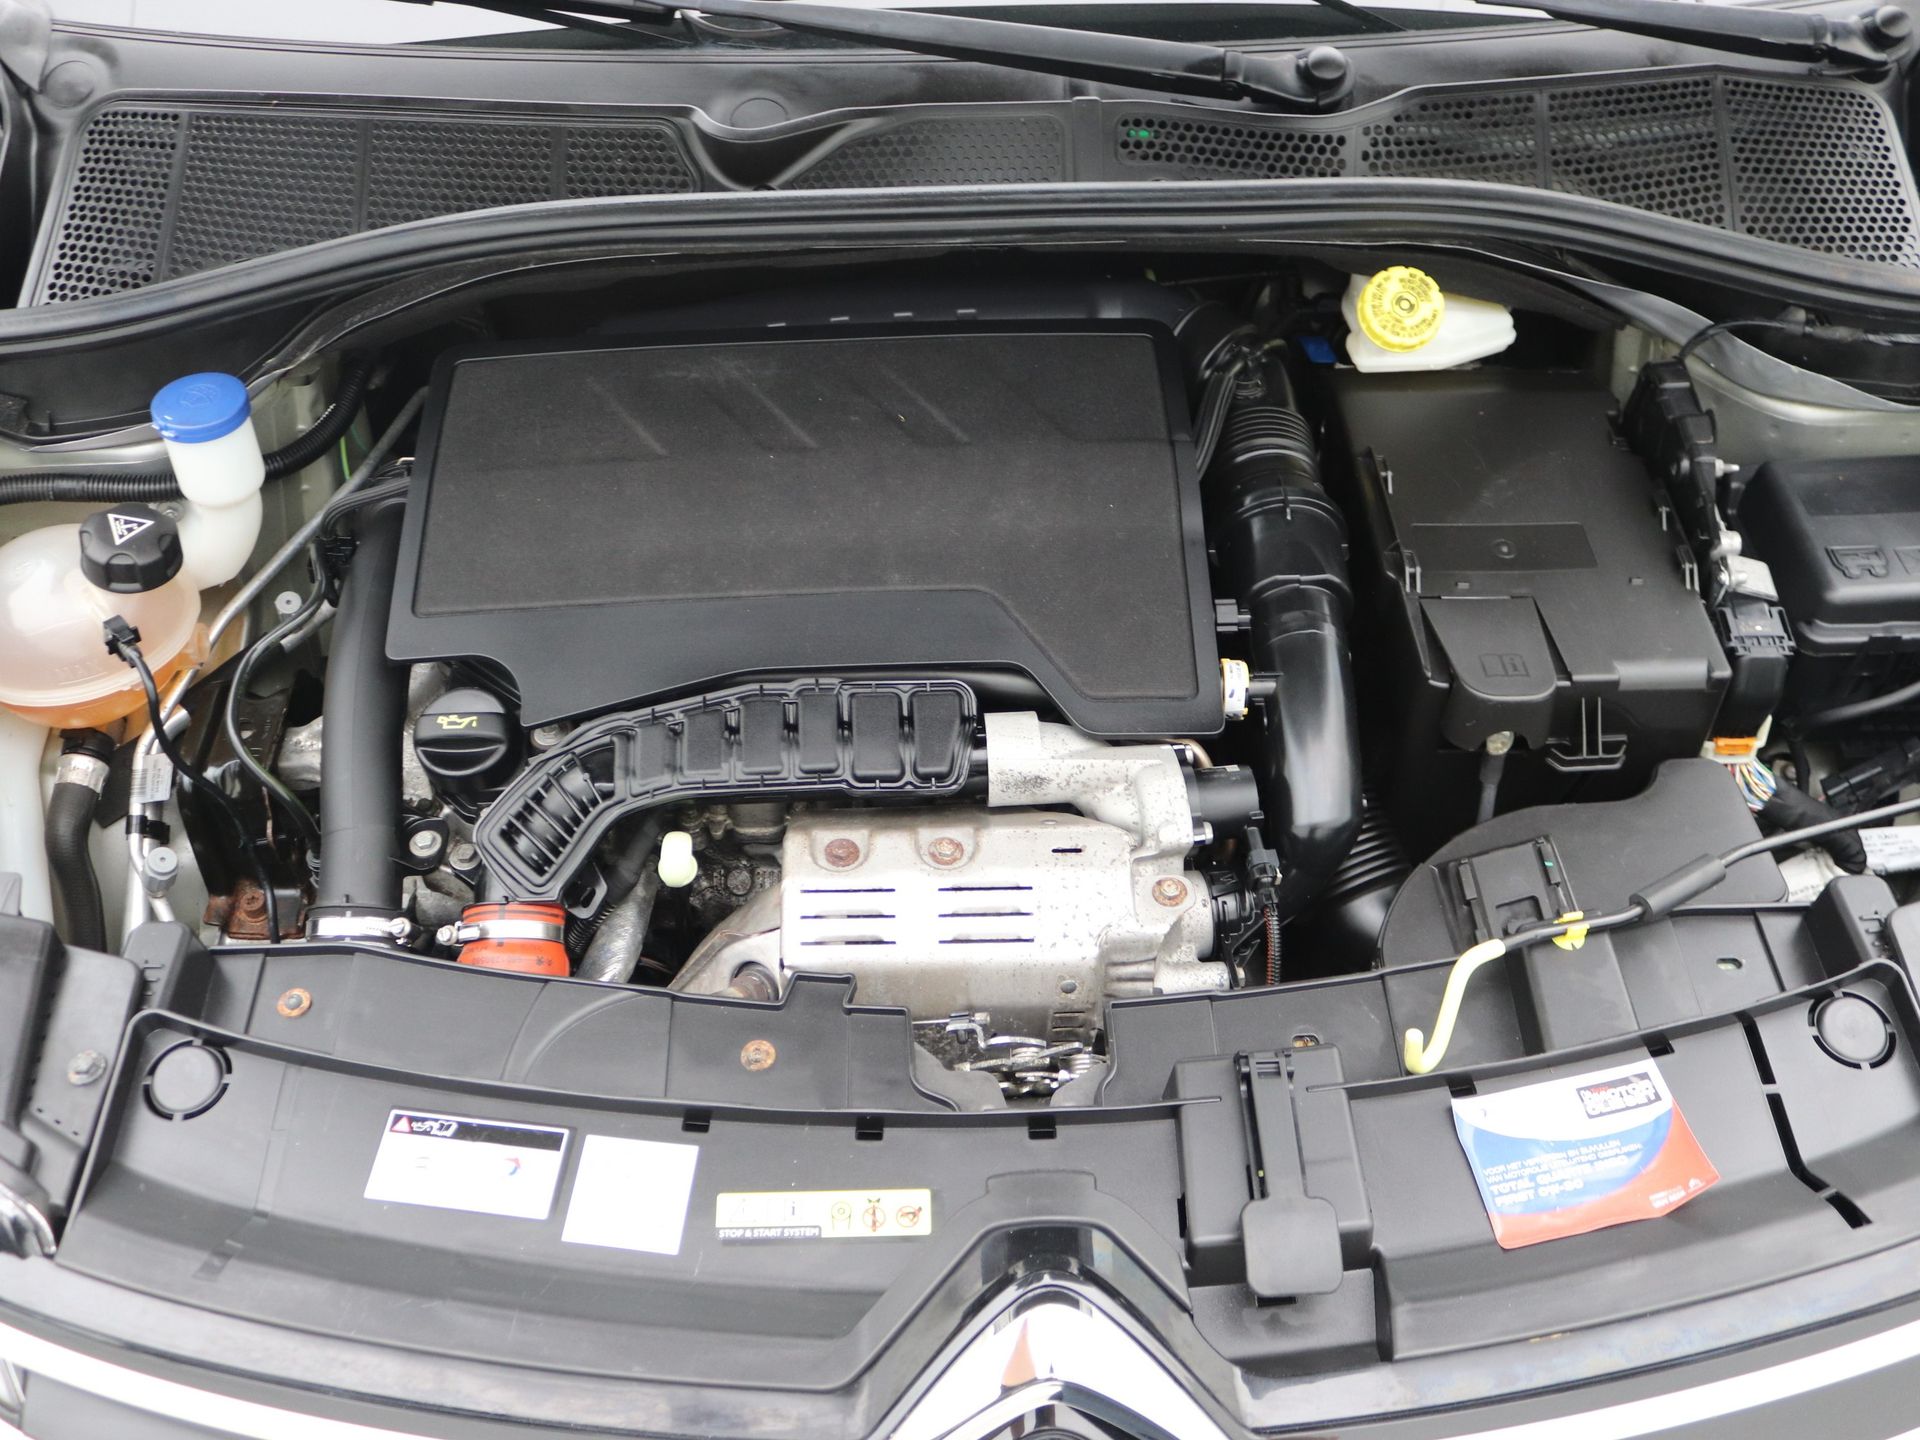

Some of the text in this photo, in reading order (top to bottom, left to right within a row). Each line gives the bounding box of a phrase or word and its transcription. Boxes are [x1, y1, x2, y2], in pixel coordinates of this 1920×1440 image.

[1483, 1165, 1506, 1176] VOOR
[1486, 1173, 1504, 1184] VAN
[1489, 1178, 1535, 1196] TOTAL
[719, 1227, 820, 1238] STOP & START SYSTEM
